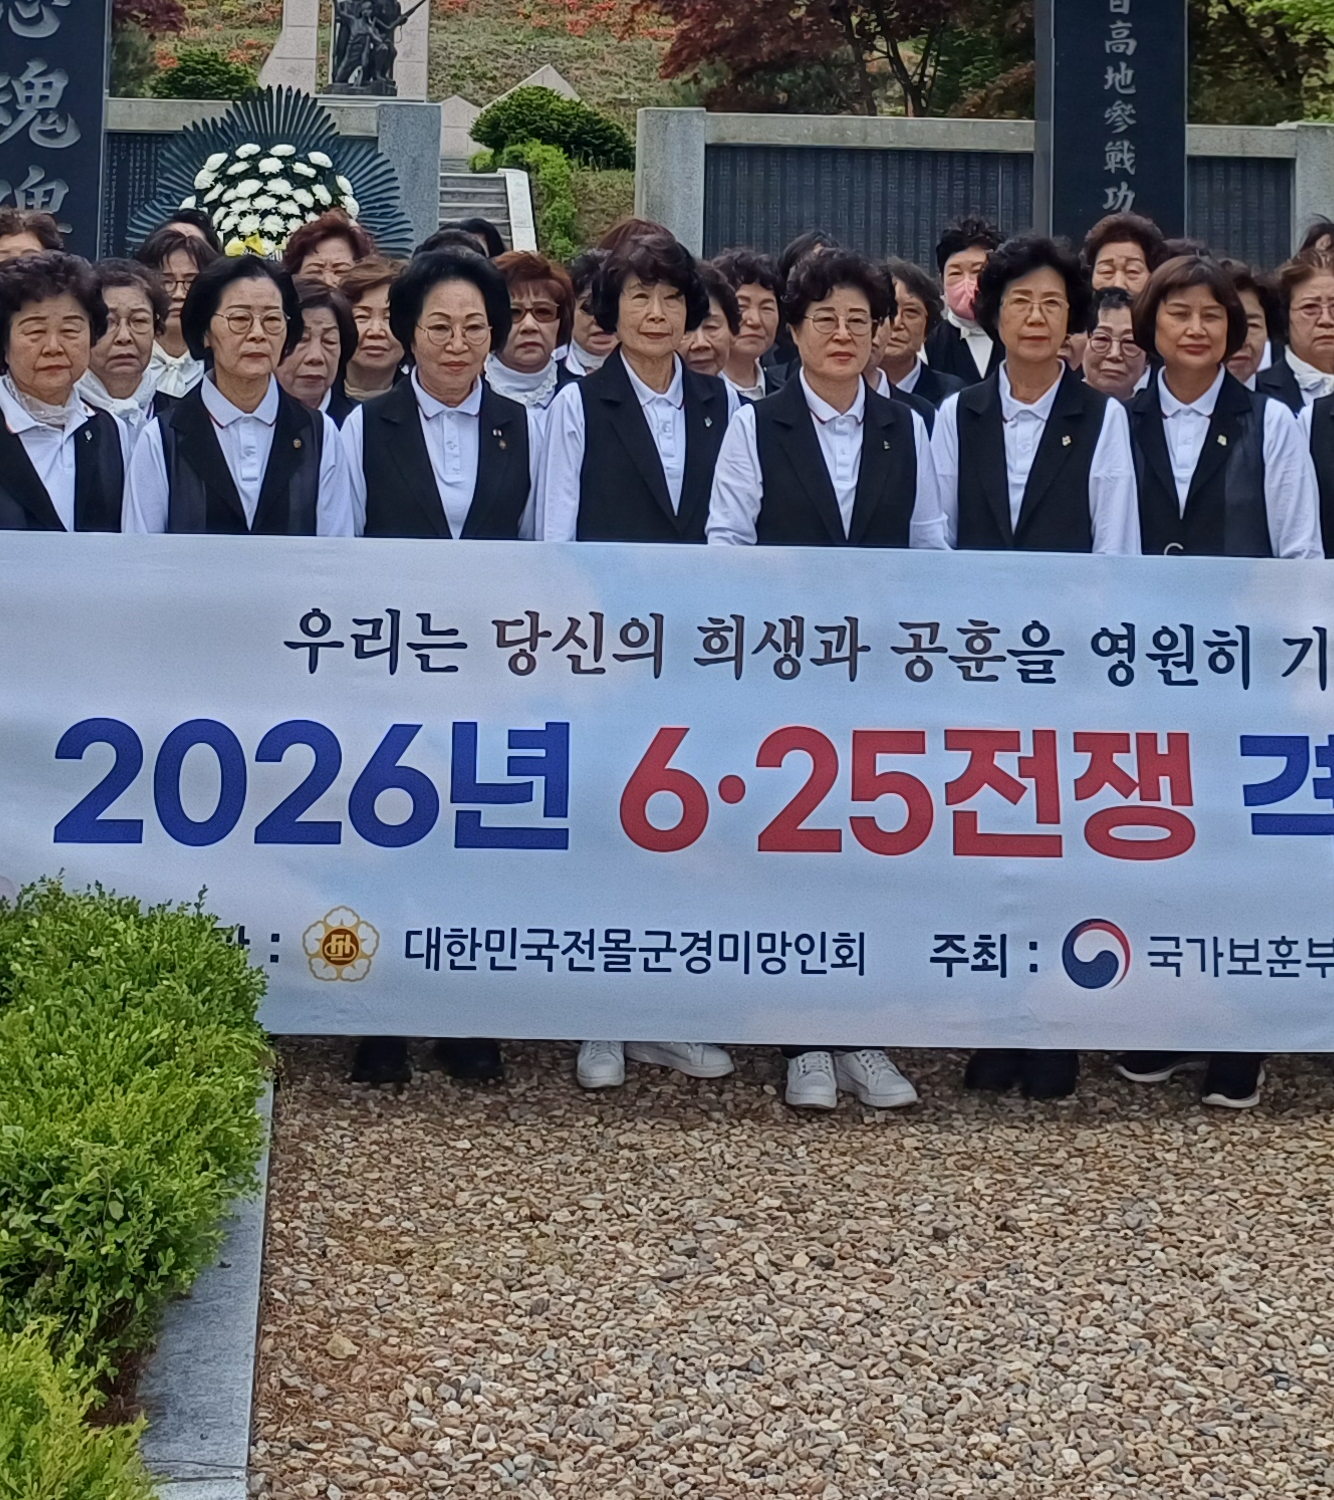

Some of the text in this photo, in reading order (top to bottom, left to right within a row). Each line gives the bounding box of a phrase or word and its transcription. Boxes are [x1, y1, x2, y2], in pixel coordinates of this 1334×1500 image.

[282, 607, 469, 676] 우리는
[490, 609, 665, 680] 당신의
[693, 613, 872, 683] 희생과
[889, 618, 1066, 685] 공훈을
[1090, 621, 1251, 691] 영원히
[52, 717, 571, 851] 2026년
[404, 926, 865, 977] 대한민국전몰군경미망인회
[929, 933, 1008, 979] 주최
